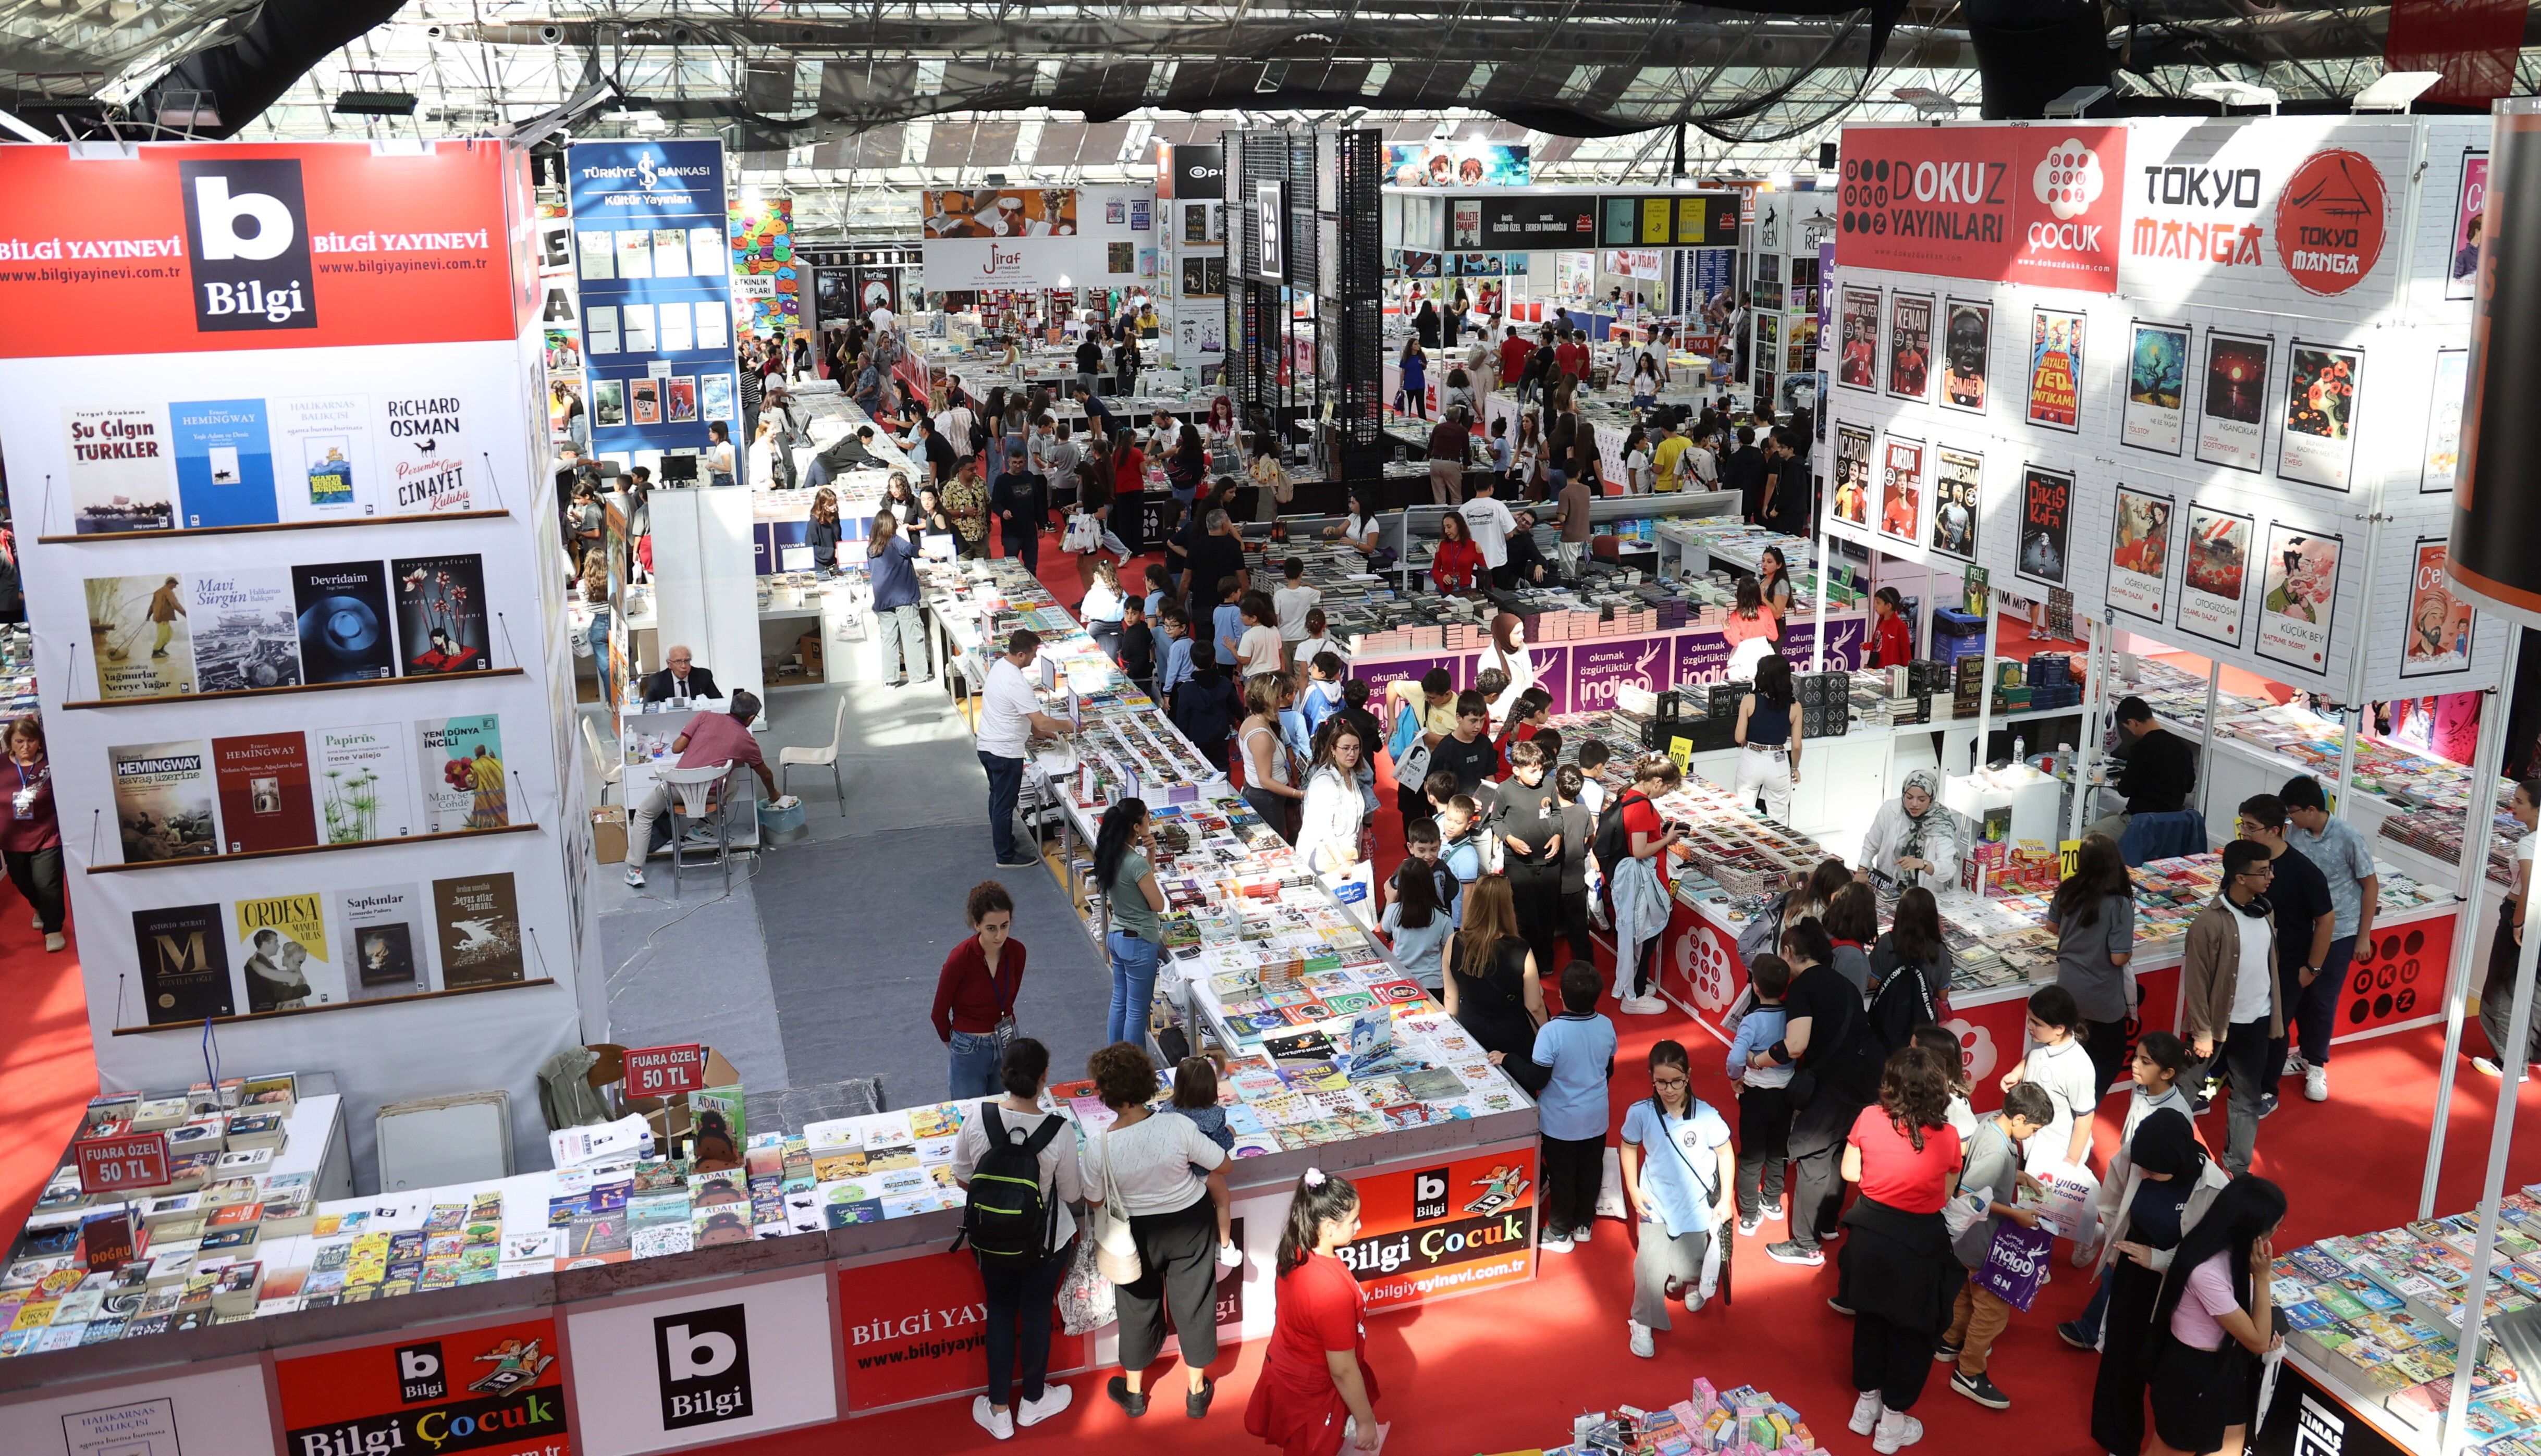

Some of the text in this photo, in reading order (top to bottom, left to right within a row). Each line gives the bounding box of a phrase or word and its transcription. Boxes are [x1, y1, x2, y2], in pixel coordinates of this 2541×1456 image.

[582, 167, 710, 179] TÜRKİYE BANKASI
[1894, 161, 2007, 204] DOKUZ
[2145, 166, 2261, 209] TOKYO
[605, 194, 692, 206] Kültür Yayınları
[194, 176, 294, 260] b
[1456, 211, 1478, 221] MİLLETE
[1456, 221, 1478, 230] EMANET
[1493, 223, 1520, 232] ÖZGÜR ÖZEL
[1526, 222, 1567, 231] EKREM İMAMOĞLU
[1891, 209, 2004, 243] YAYINLARI
[314, 228, 489, 253] BİLGİ YAYINEVİ
[2028, 221, 2102, 254] ÇOCUK
[2132, 216, 2263, 267] MANGA
[2300, 226, 2358, 248] TOKYO
[0, 234, 181, 261] BİLGİ YAYINEVİ
[319, 257, 487, 275] www.bilgiyayinevi.com.tr
[2018, 258, 2110, 273] www.dokuzdukkan.com
[2292, 250, 2359, 275] MANGA
[0, 265, 180, 284] www.bilgiyayinevi.com.tr
[735, 278, 768, 287] ETKİNLİK
[204, 280, 305, 323] Bilgi
[1230, 292, 1241, 303] ALEX
[1861, 304, 1877, 318] ALPER
[1897, 307, 1927, 331] KENAN
[2040, 355, 2069, 371] HAYALET
[182, 414, 255, 425] HEMINGWAY
[390, 417, 460, 437] OSMAN
[72, 419, 154, 441] Şu Çılgın
[2128, 425, 2150, 436] TOLSTOY
[2218, 421, 2257, 437] İNSANCIKLAR
[74, 442, 159, 461] TÜRKLER
[2203, 440, 2239, 453] DOSTOYEVSKİ
[1891, 447, 1916, 471] ARDA
[2284, 457, 2303, 467] ZWEIG
[1938, 460, 1980, 485] QUARESMA
[398, 467, 463, 507] CİNAYET
[430, 490, 469, 511] Kulübü
[401, 561, 434, 569] zeynep
[311, 573, 367, 586] Devridaim
[1970, 567, 1984, 582] PELÉ
[196, 578, 234, 593] Mavi
[2124, 577, 2162, 596] ÖĞRENCİ KIZ
[198, 592, 247, 608] Sürgün
[1790, 634, 1815, 644] okuma
[2280, 622, 2325, 644] KÜÇÜK BEY
[1691, 641, 1725, 653] okumak
[1589, 651, 1625, 663] okumak
[1683, 652, 1730, 666] özgürlüktü
[104, 671, 158, 682] Yağmurlar
[1371, 671, 1409, 683] okumak
[1580, 662, 1633, 676] özgürlüktür
[143, 681, 170, 690] Yağar
[1580, 676, 1653, 702] indigo
[325, 734, 376, 748] Papirüs
[423, 727, 479, 738] YENİ DÜNYA
[424, 737, 458, 748] İNCİLİ
[226, 746, 294, 759] HEMINGWAY
[117, 757, 199, 775] HEMINGWAY
[119, 771, 200, 785] savaş üzerine
[429, 792, 468, 803] Maryse
[439, 799, 469, 809] Condé
[347, 894, 403, 909] Sapkınlar
[244, 897, 318, 928] ORDESA
[292, 922, 319, 931] MANUEL
[154, 931, 212, 975] M
[632, 1050, 697, 1068] FUARA ÖZEL
[643, 1067, 690, 1089] 50 TL
[698, 1095, 726, 1112] ADALI
[86, 1143, 157, 1162] FUARA ÖZEL
[100, 1159, 151, 1183] 50 TL
[1417, 1176, 1445, 1201] b
[1416, 1203, 1445, 1217] Bilgi
[1335, 1215, 1523, 1272] Bilgi Çocuk
[91, 1245, 132, 1265] DOĞRU
[1992, 1242, 2035, 1277] indigo
[852, 1308, 932, 1346] BİLGİ
[666, 1324, 736, 1382] b
[401, 1351, 439, 1380] b
[406, 1381, 444, 1398] Bilgi
[670, 1386, 744, 1418] Bilgi
[82, 1407, 156, 1426] HALİKARNAS
[94, 1418, 149, 1435] BALIKÇISI
[300, 1395, 554, 1456] Bilgi Çocuk
[2300, 1408, 2342, 1451] TİMAŞ
